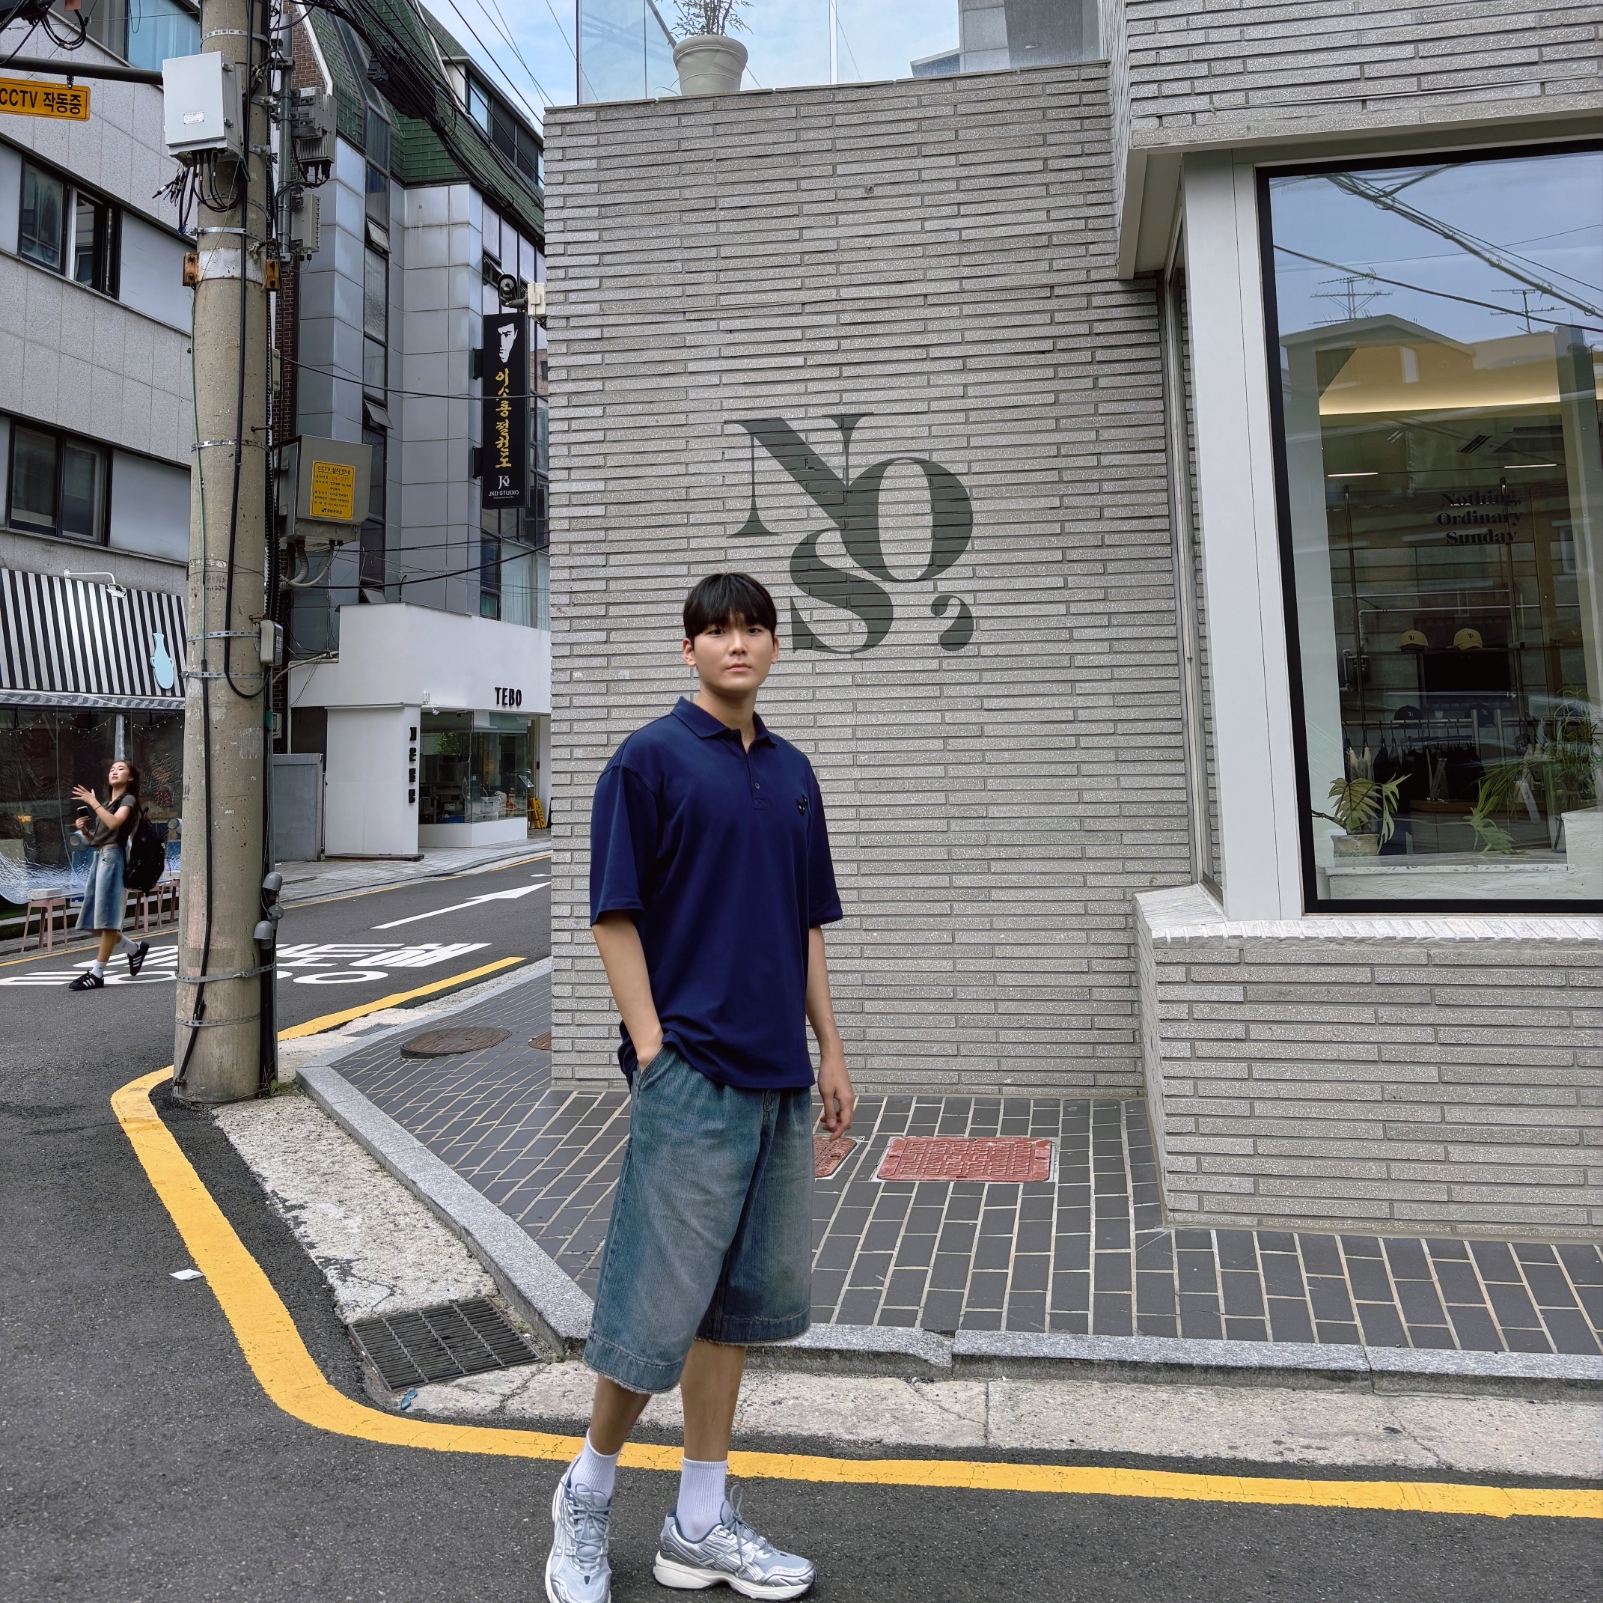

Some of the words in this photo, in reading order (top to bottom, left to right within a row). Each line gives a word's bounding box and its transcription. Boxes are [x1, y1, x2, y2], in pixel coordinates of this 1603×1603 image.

[0, 88, 38, 108] CCTV
[43, 92, 82, 115] 작동중
[1437, 510, 1523, 526] Ordinary
[1446, 528, 1517, 545] Sunday
[495, 686, 522, 706] TEBO
